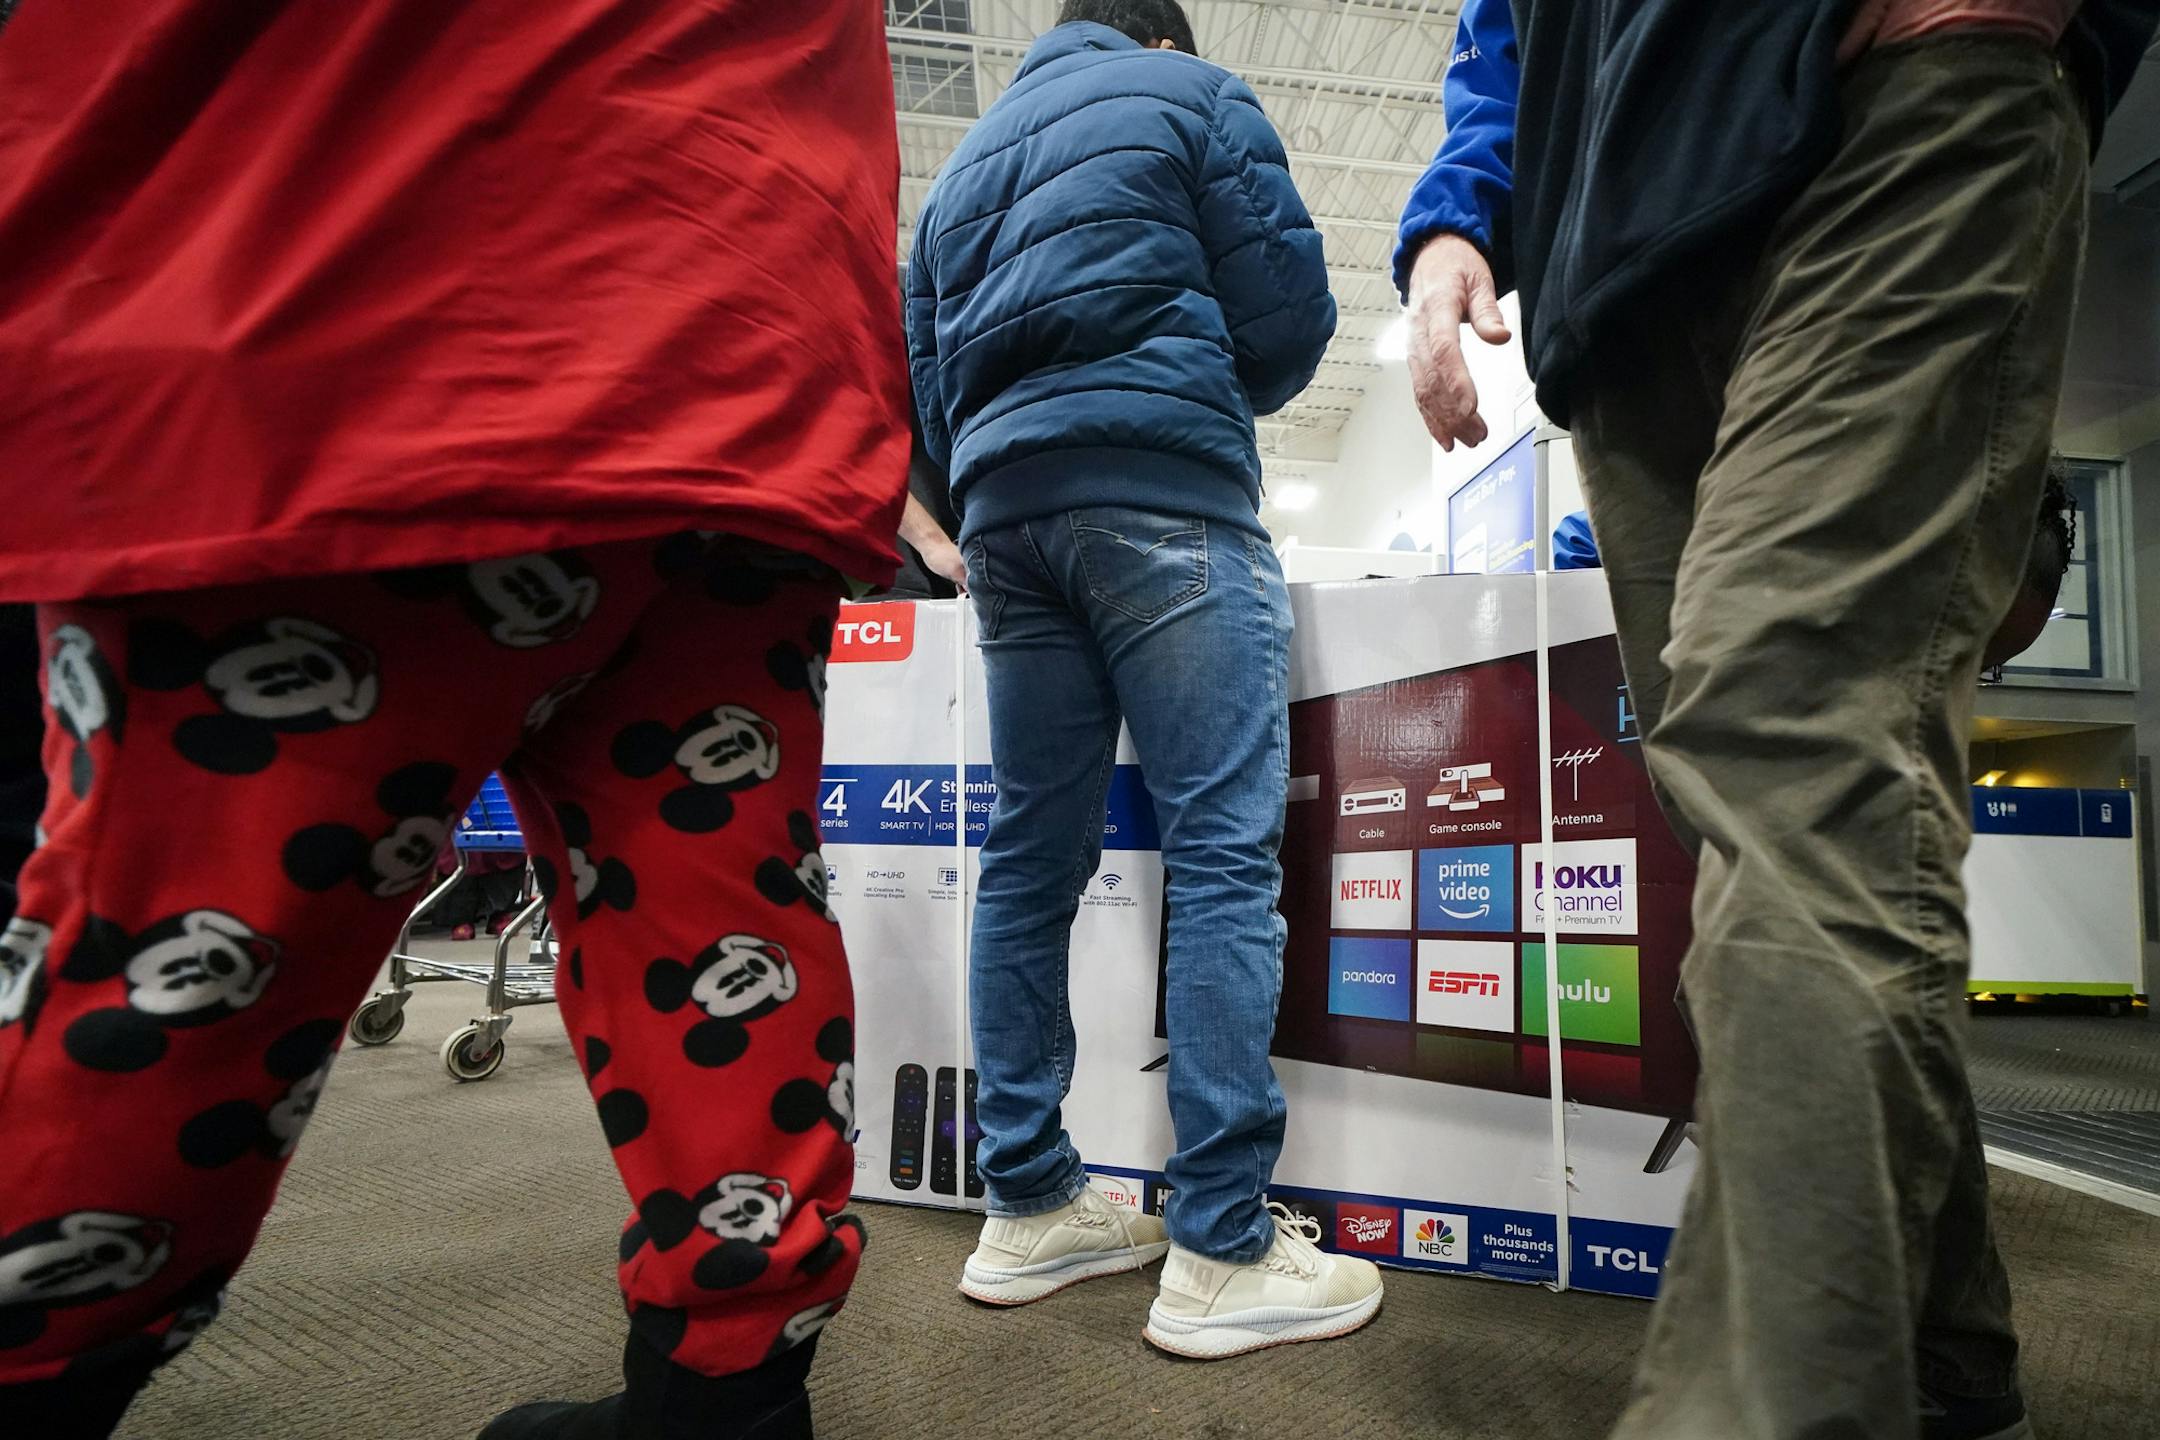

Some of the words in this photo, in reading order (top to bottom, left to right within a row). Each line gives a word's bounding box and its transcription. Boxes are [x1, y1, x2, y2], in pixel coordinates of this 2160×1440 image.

[838, 621, 901, 645] TCL
[941, 780, 997, 793] Stnnin
[822, 783, 848, 817] 4
[881, 779, 934, 814] 4K
[941, 799, 995, 813] Enless
[820, 818, 849, 829] series
[880, 821, 910, 830] SMART
[913, 822, 925, 830] TV
[935, 822, 955, 831] HDR
[966, 822, 986, 831] UHD
[1429, 823, 1458, 834] Game
[1460, 819, 1502, 832] console
[1552, 813, 1604, 826] Antenna
[1359, 828, 1385, 839] Cable
[1439, 859, 1490, 882] prime
[1341, 879, 1402, 901] NETFLIX
[1439, 881, 1490, 901] video
[1564, 915, 1606, 925] Premium
[1608, 915, 1622, 925] TV
[1342, 970, 1396, 984] pandora
[1428, 970, 1500, 997] ESPN
[1341, 1215, 1392, 1235] Disney
[1504, 1223, 1533, 1237] Plus
[1356, 1228, 1387, 1244] NOW
[1483, 1234, 1554, 1252] thousands
[1418, 1242, 1452, 1257] NBC
[1587, 1244, 1659, 1274] TCL
